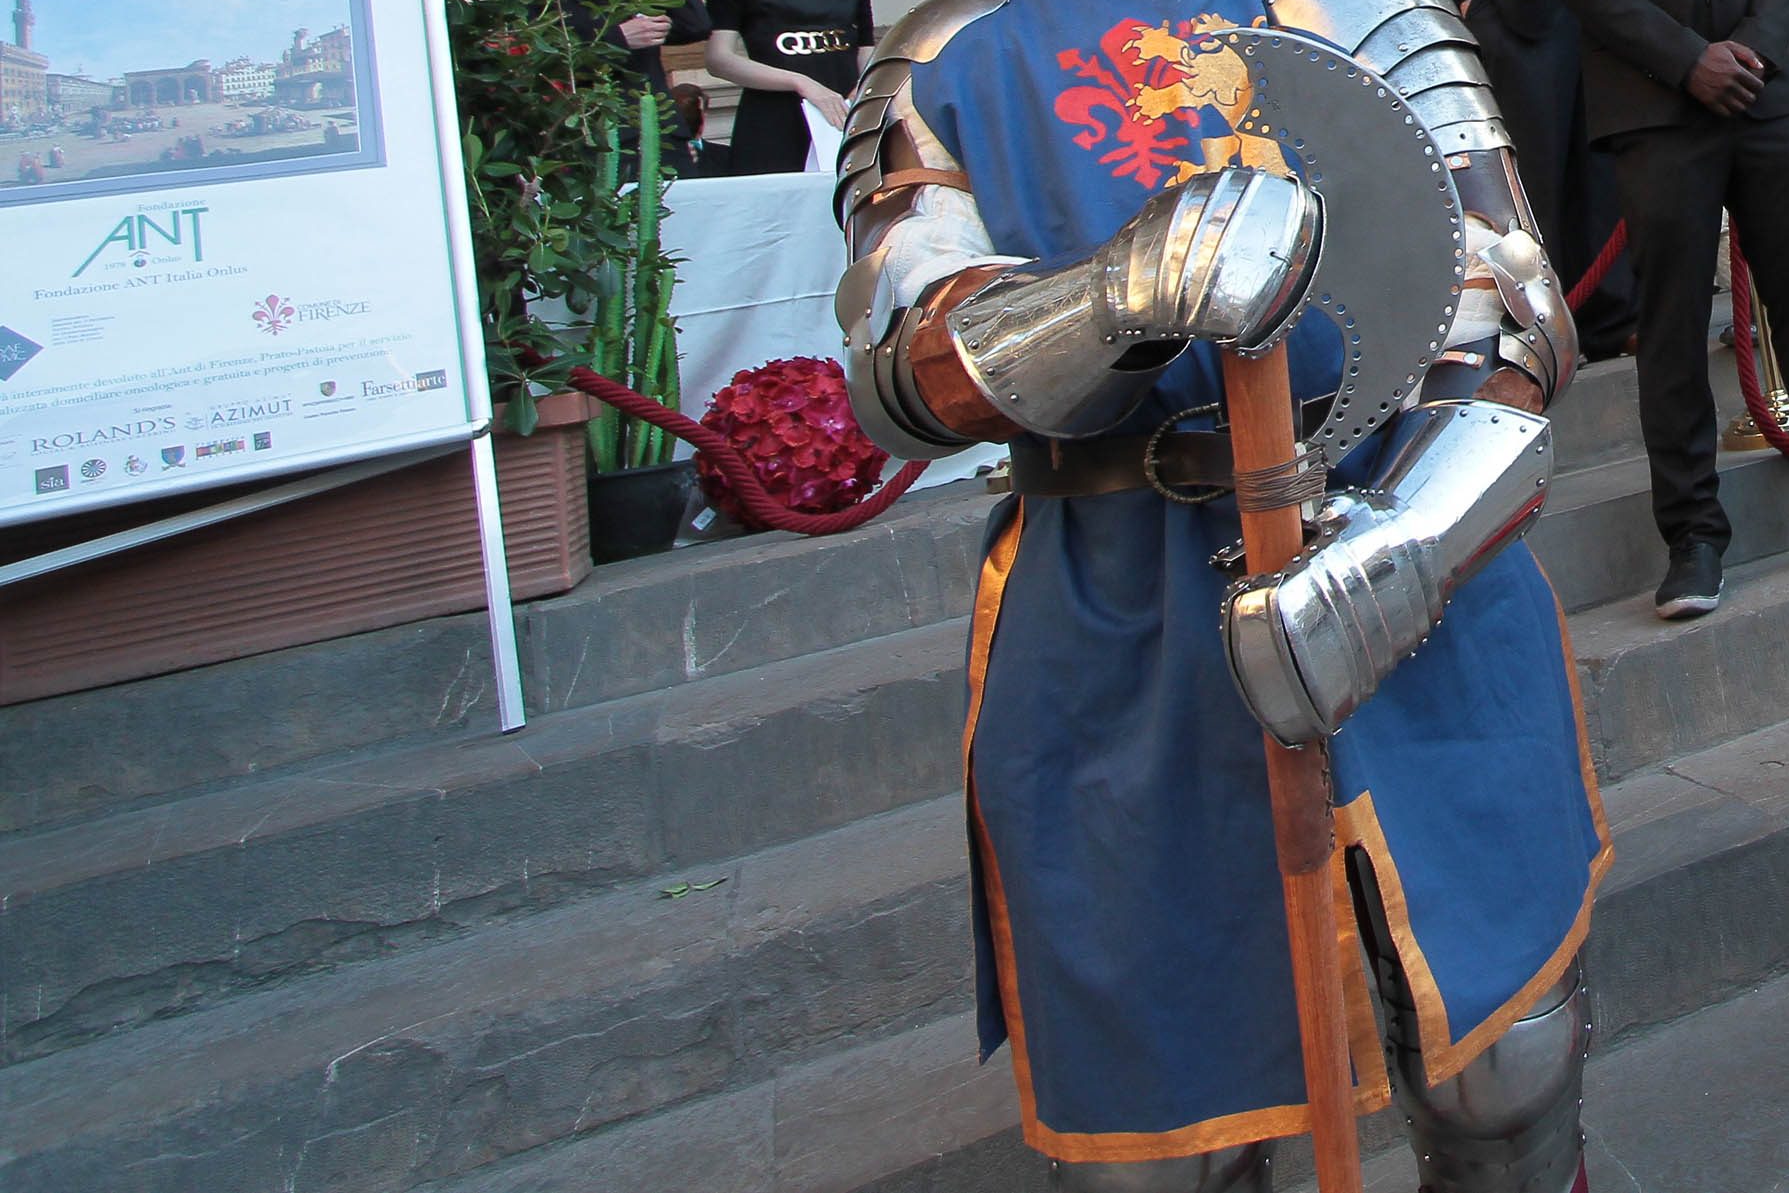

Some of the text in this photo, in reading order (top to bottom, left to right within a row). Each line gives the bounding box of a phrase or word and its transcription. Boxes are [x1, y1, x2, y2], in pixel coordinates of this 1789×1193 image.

[137, 199, 206, 212] Fondazione
[72, 207, 209, 278] ANT
[34, 265, 248, 300] Fondazione ANT Italia Onlus
[298, 301, 372, 322] FIRENZE
[12, 384, 90, 399] interamente
[194, 362, 206, 371] di
[338, 342, 356, 352] per
[51, 391, 122, 408] domiciliare
[124, 380, 189, 395] oncologica
[204, 370, 251, 385] gratuita
[264, 361, 309, 377] progetti
[313, 358, 323, 367] di
[211, 399, 292, 424] AZIMUT
[31, 416, 176, 452] ROLAND'S
[40, 476, 65, 489] sia
